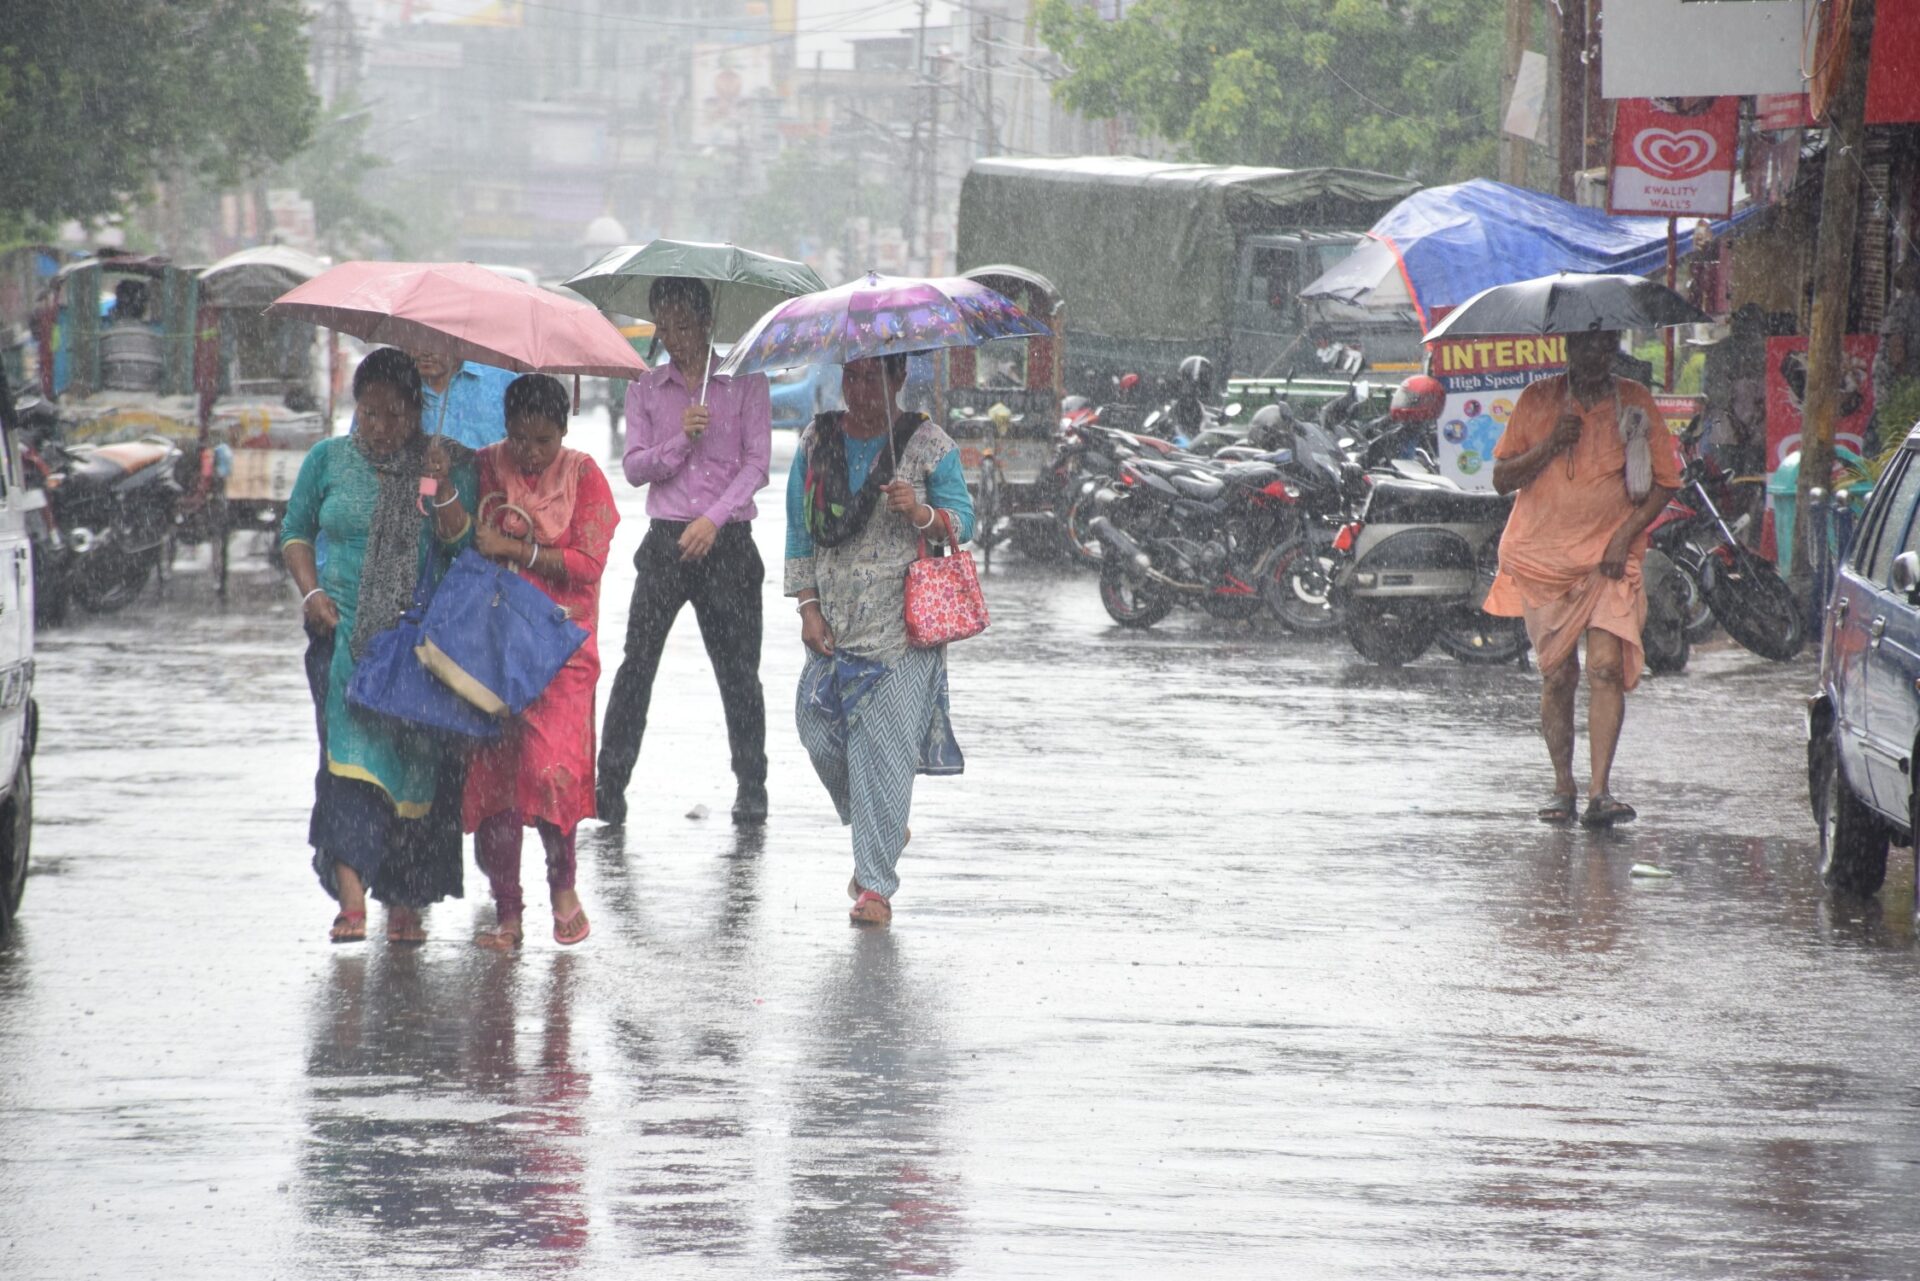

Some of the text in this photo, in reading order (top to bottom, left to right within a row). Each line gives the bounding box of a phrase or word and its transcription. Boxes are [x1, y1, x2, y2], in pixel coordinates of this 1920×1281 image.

[1644, 186, 1698, 196] KWALITY
[1649, 199, 1692, 209] WALL'S
[1450, 371, 1563, 390] High Speed Int
